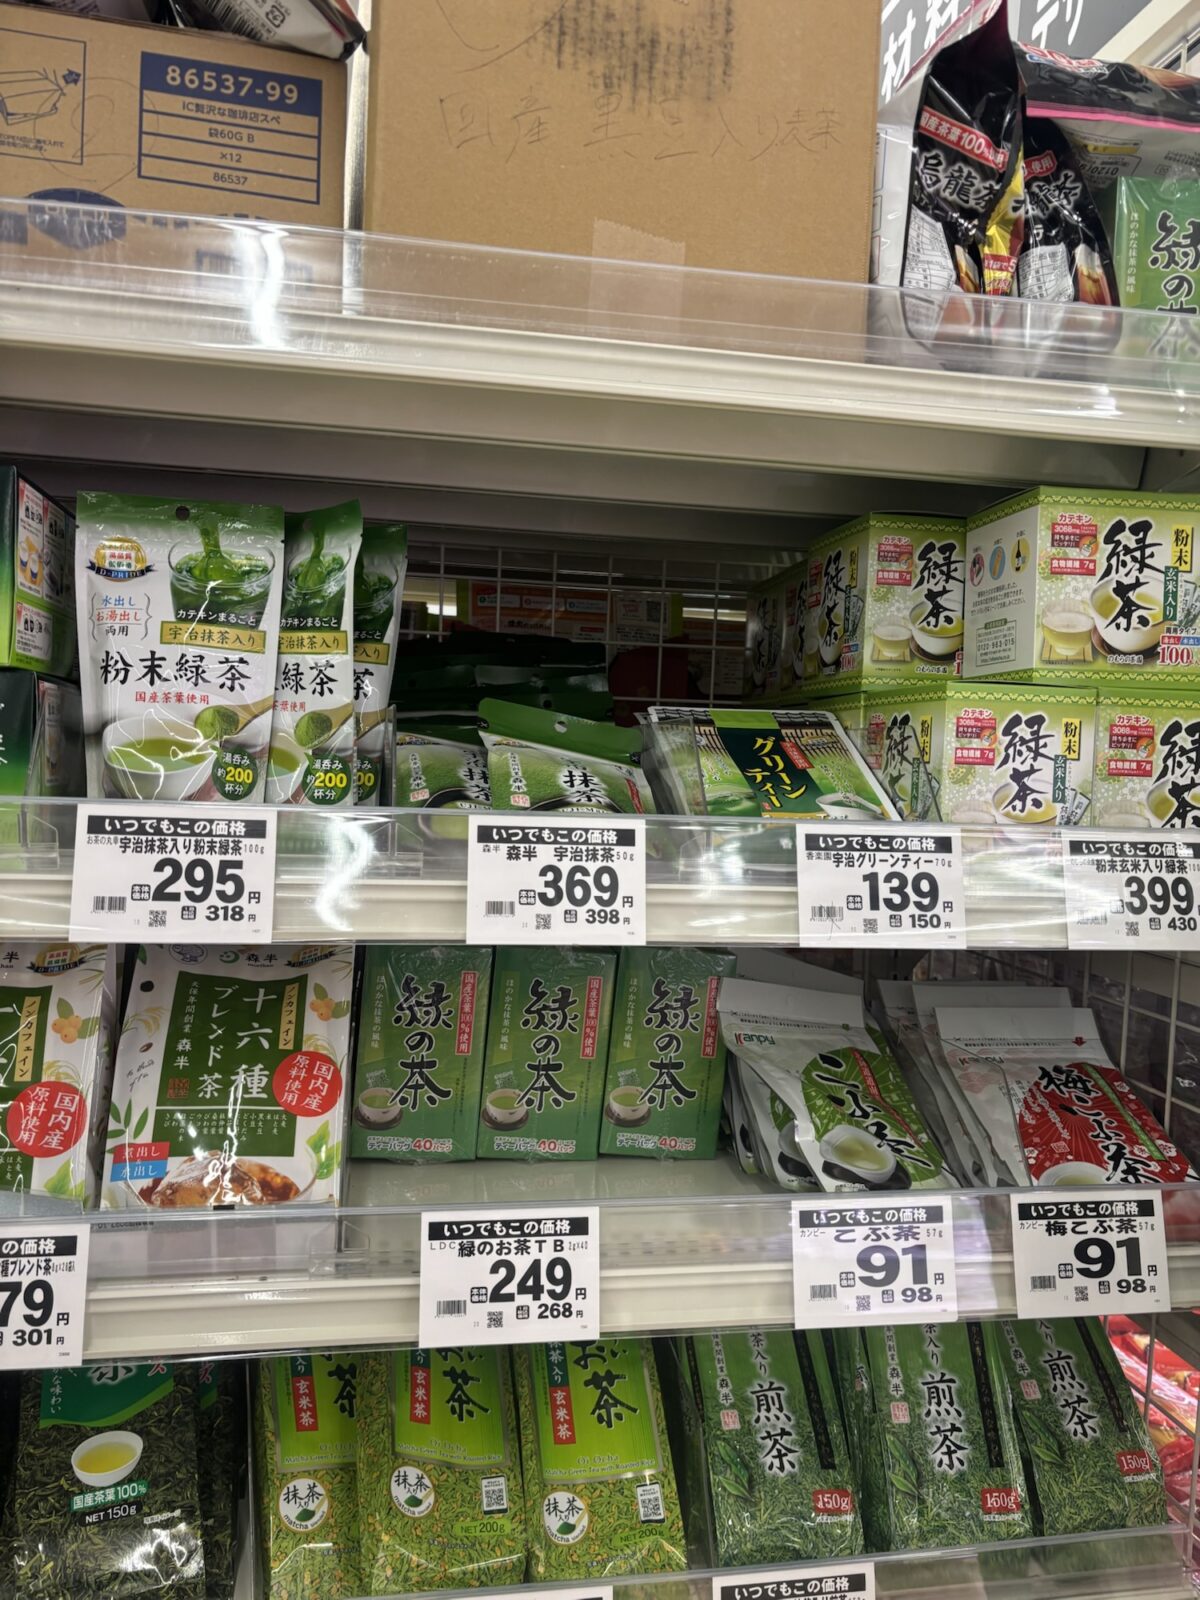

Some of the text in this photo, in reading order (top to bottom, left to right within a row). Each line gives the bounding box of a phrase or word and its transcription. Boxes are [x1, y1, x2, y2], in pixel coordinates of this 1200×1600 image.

[165, 64, 299, 105] 86537-99
[208, 127, 255, 143] 袋60G B
[213, 172, 248, 186] 86537
[1059, 514, 1092, 524] カテキン
[883, 536, 911, 545] カテキン
[1174, 529, 1189, 567] 粉末
[912, 541, 965, 628] 緑茶
[1097, 519, 1165, 632] 緑茶
[101, 595, 136, 607] 水出し
[1166, 568, 1177, 619] 玄米入り
[96, 611, 141, 622] お湯出し
[177, 609, 256, 626] カテキンまるごと
[105, 625, 129, 637] 両用
[169, 625, 256, 647] 宇治抹茶入り
[100, 650, 252, 692] 粉末緑茶
[135, 690, 209, 705] 国産茶葉使用
[962, 708, 993, 718] カテキン
[1117, 715, 1150, 725] カテキン
[1064, 722, 1078, 756] 粉末
[223, 752, 250, 766] 湯呑み
[313, 759, 342, 770] 湯呑み
[753, 736, 806, 799] グリーン
[995, 713, 1055, 814] 緑茶
[225, 784, 244, 796] 杯分
[745, 768, 781, 807] ティー
[1054, 756, 1065, 803] 玄米入り
[313, 788, 336, 800] 杯分
[105, 818, 246, 836] いつでもこの価格
[492, 828, 618, 845] いつでもこの価格
[119, 837, 242, 856] 宇治抹茶入り粉末緑茶
[244, 844, 264, 854] 100g
[482, 845, 634, 862] 森半 森半 宇治抹茶 50g
[819, 836, 936, 851] いつでもこの価格
[832, 852, 933, 869] 宇治グリーンティー
[935, 858, 952, 867] 70g
[1095, 859, 1188, 874] 粉末玄米入り緑茶
[151, 857, 260, 904] 295 円
[537, 864, 633, 908] 369 円
[862, 871, 953, 913] 139 円
[1125, 876, 1194, 915] 399
[205, 905, 245, 922] 318
[248, 914, 256, 922] 円
[585, 909, 620, 924] 398
[623, 917, 630, 925] 円
[909, 914, 941, 928] 150
[944, 921, 951, 929] 円
[1167, 917, 1197, 931] 430
[282, 985, 298, 1046] ノンカフェイン
[371, 975, 385, 1049] ほのかな抹茶の風味
[458, 972, 475, 1054] 国産茶葉100%使用
[584, 978, 600, 1057] 国産茶葉100%使用
[623, 978, 638, 1048] ほのかな抹茶の風味
[18, 1000, 37, 1080] ノンカフェイン
[197, 985, 239, 1099] ブレンド茶
[231, 988, 277, 1099] 十六種
[388, 973, 453, 1112] 緑の茶
[515, 978, 579, 1113] 緑の茶
[638, 977, 701, 1109] 緑の茶
[735, 1033, 776, 1047] Kanpy
[174, 1038, 192, 1070] 森半
[282, 1054, 309, 1106] 原料使用
[301, 1060, 335, 1113] 国内産
[17, 1087, 50, 1147] 原料使用
[814, 1052, 933, 1168] こぶ茶
[39, 1092, 79, 1150] 国内産
[813, 1208, 927, 1224] いつでもこの価格
[1031, 1202, 1139, 1217] いつでもこの価格
[444, 1219, 571, 1236] いつでもこの価格
[834, 1225, 943, 1243] こぶ茶 57g
[1045, 1218, 1155, 1237] 梅こぶ茶 57g
[2, 1238, 56, 1255] の価格
[856, 1244, 944, 1287] 91 円
[1074, 1237, 1157, 1279] 91 円
[489, 1257, 587, 1303] 249 円
[1117, 1279, 1146, 1294] 98
[1150, 1285, 1156, 1293] 円
[0, 1279, 70, 1328] 79 円
[901, 1287, 933, 1303] 98
[537, 1303, 573, 1319] 268
[576, 1310, 583, 1318] 円
[12, 1328, 64, 1347] 301 円
[414, 1372, 428, 1418] 玄米茶
[719, 1378, 732, 1404] 森半
[1044, 1351, 1098, 1438] 煎茶
[297, 1379, 315, 1426] 玄米茶
[553, 1390, 572, 1440] 玄米茶
[921, 1373, 968, 1470] 煎茶
[750, 1382, 800, 1474] 煎茶
[1121, 1455, 1147, 1471] 150g
[395, 1470, 431, 1491] 抹茶
[407, 1486, 418, 1495] 入り
[73, 1483, 147, 1510] 国産茶葉100%
[283, 1482, 325, 1504] 抹茶
[817, 1493, 849, 1511] 150g
[985, 1491, 1016, 1509] 150g
[86, 1512, 105, 1524] NET
[107, 1505, 137, 1520] 150g
[296, 1500, 308, 1509] 入り
[394, 1495, 416, 1516] matcha
[545, 1496, 583, 1517] 抹茶
[283, 1514, 308, 1530] matcha
[461, 1521, 505, 1535] NET 200g
[546, 1524, 570, 1543] matcha
[620, 1527, 664, 1543] NET 200g
[735, 1576, 850, 1600] いつでもこの価格
